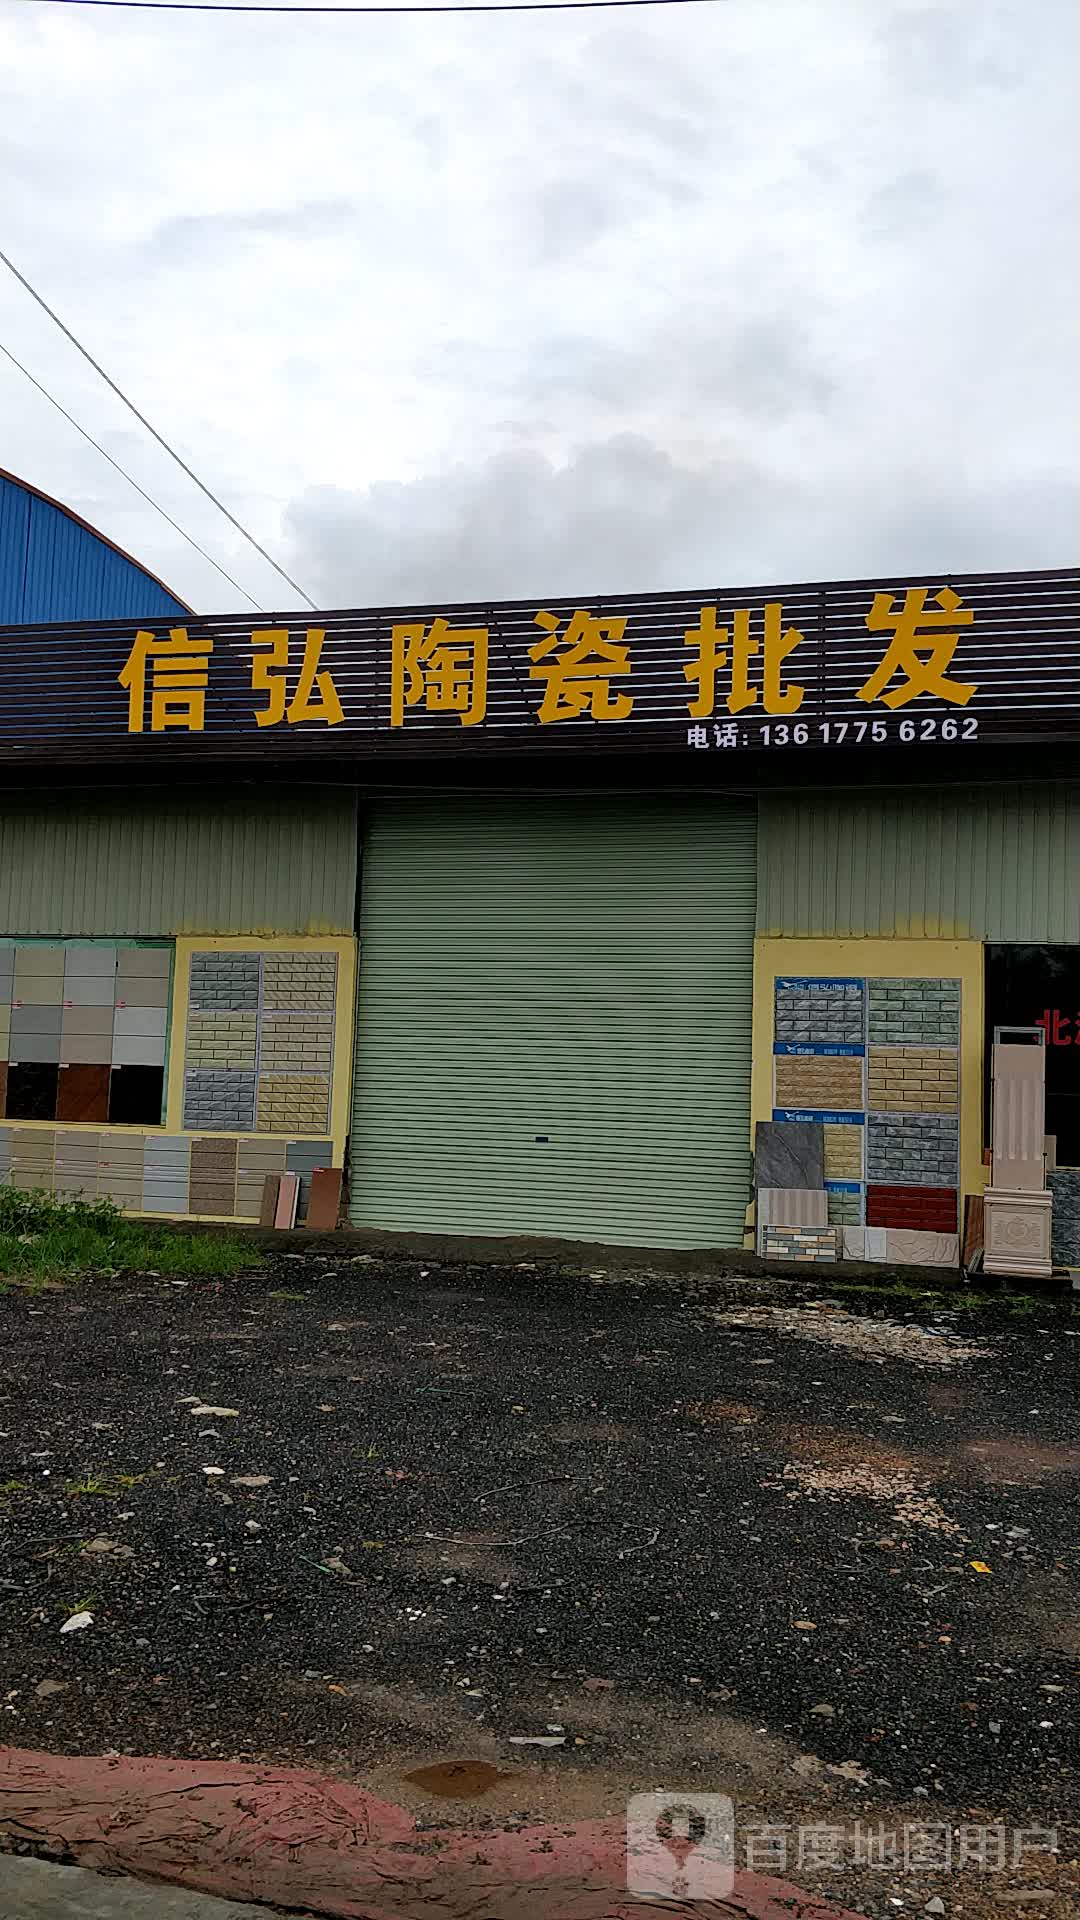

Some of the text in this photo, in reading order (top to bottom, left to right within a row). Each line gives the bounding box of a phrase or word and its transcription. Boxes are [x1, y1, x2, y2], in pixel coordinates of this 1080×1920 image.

[118, 587, 979, 733] 信弘陶瓷批发
[759, 723, 809, 746] 136
[818, 721, 888, 743] 1775
[899, 717, 979, 742] 6262
